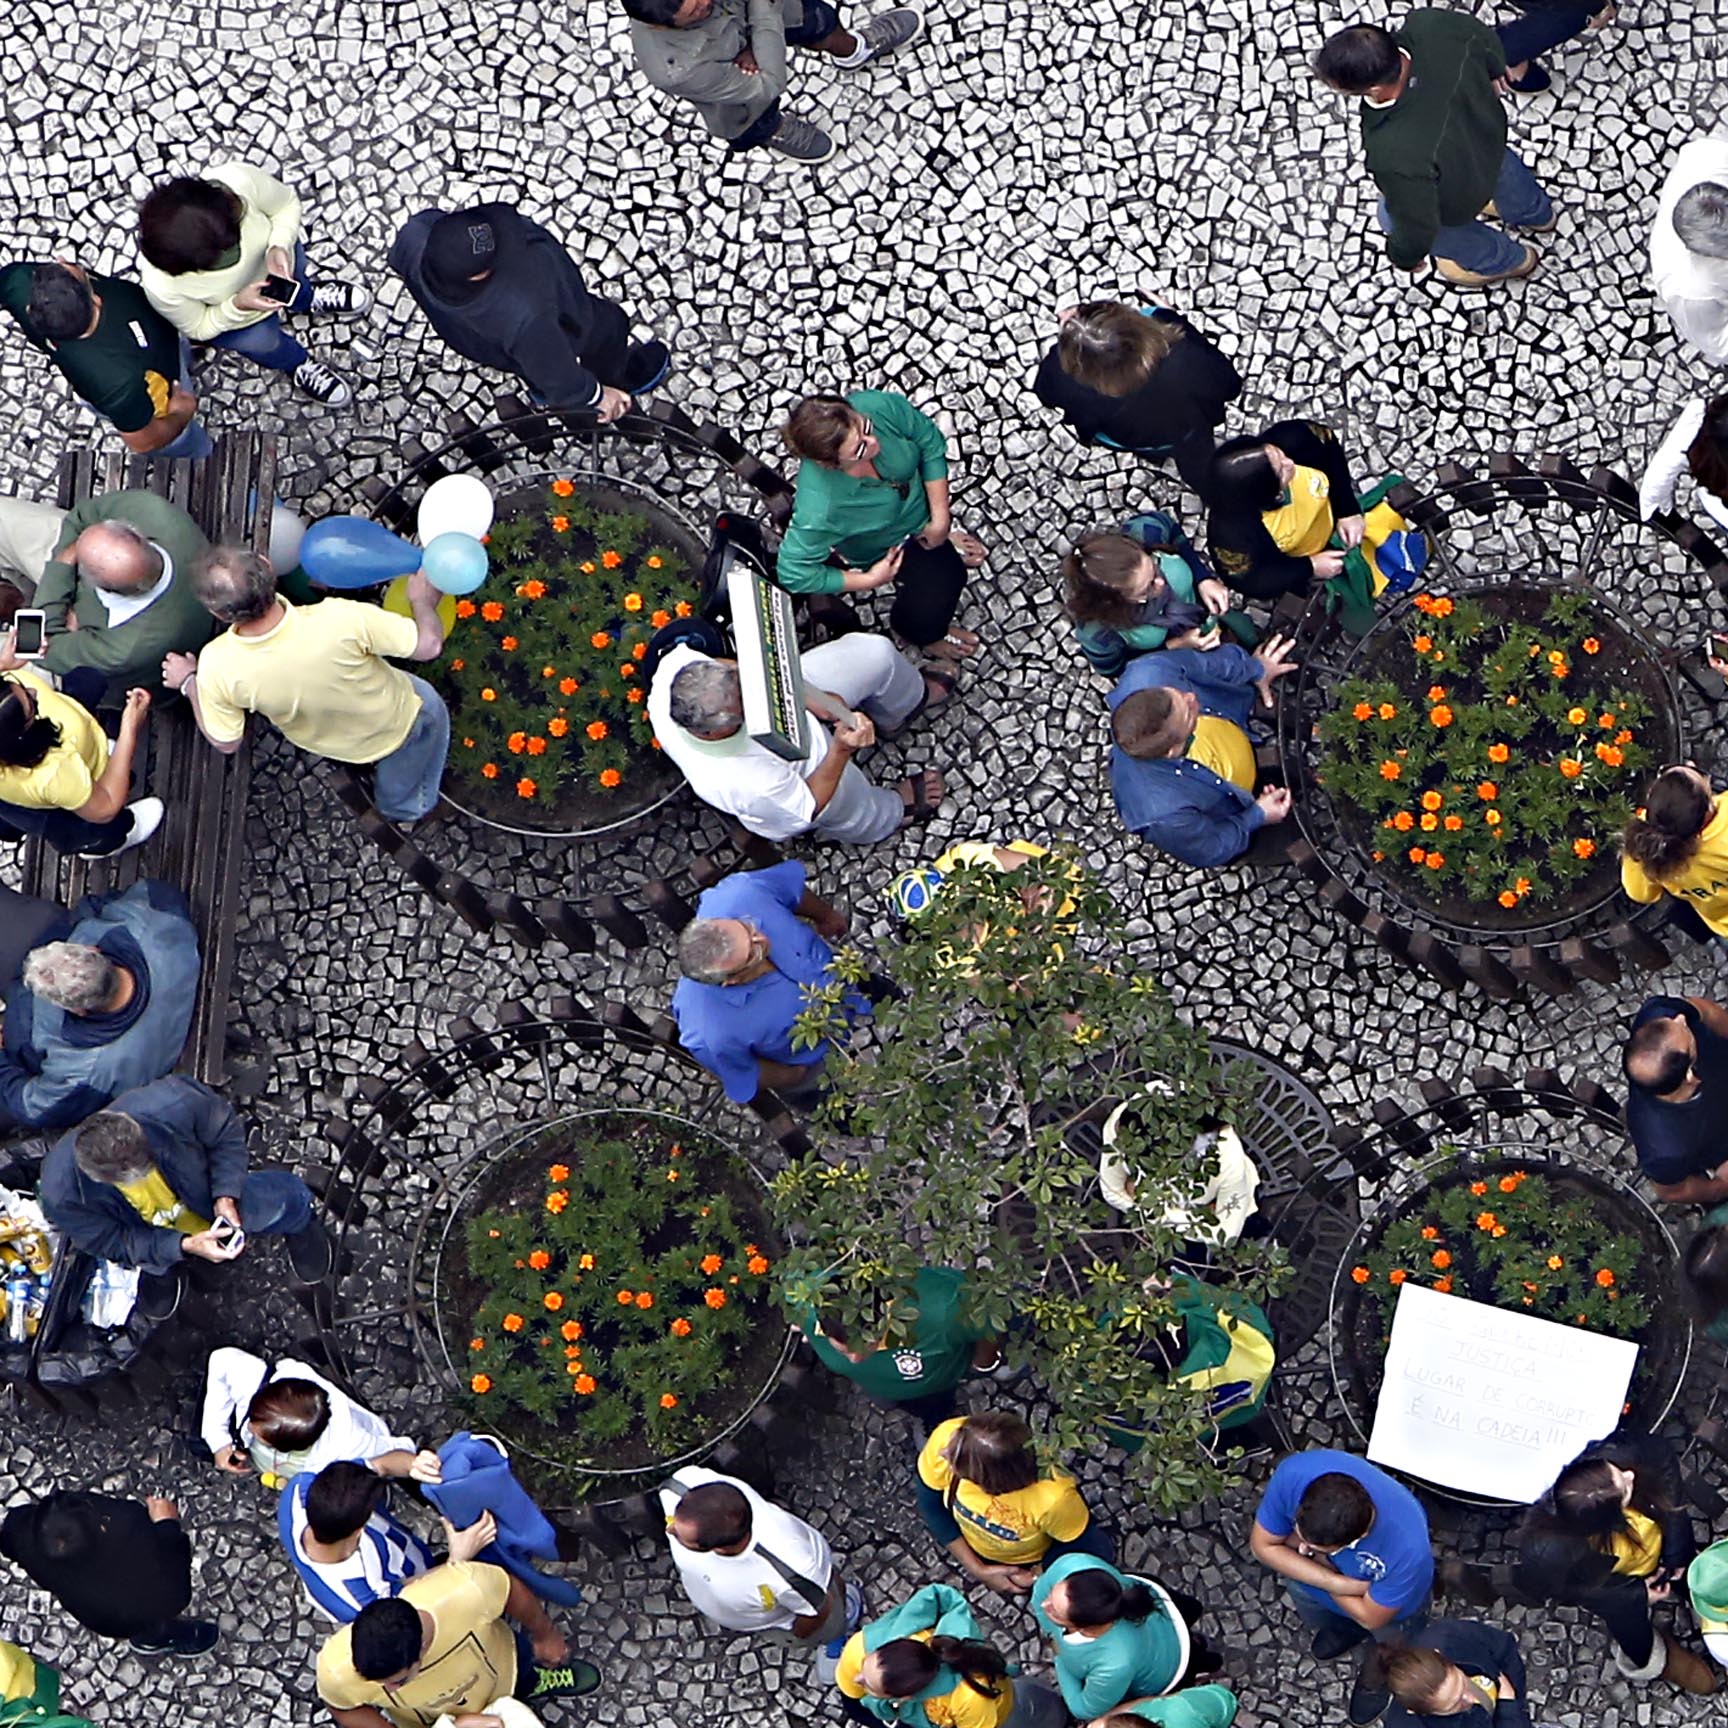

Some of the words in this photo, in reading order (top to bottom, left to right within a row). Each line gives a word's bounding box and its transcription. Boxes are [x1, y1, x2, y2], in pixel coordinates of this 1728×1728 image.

[1404, 1359, 1466, 1393] LUGAR
[1482, 1384, 1502, 1403] DE
[1451, 1340, 1537, 1378] JUSTIÇA
[1410, 1393, 1424, 1416] É
[1434, 1405, 1461, 1428] NA
[1476, 1416, 1566, 1447] CADEIA!!!
